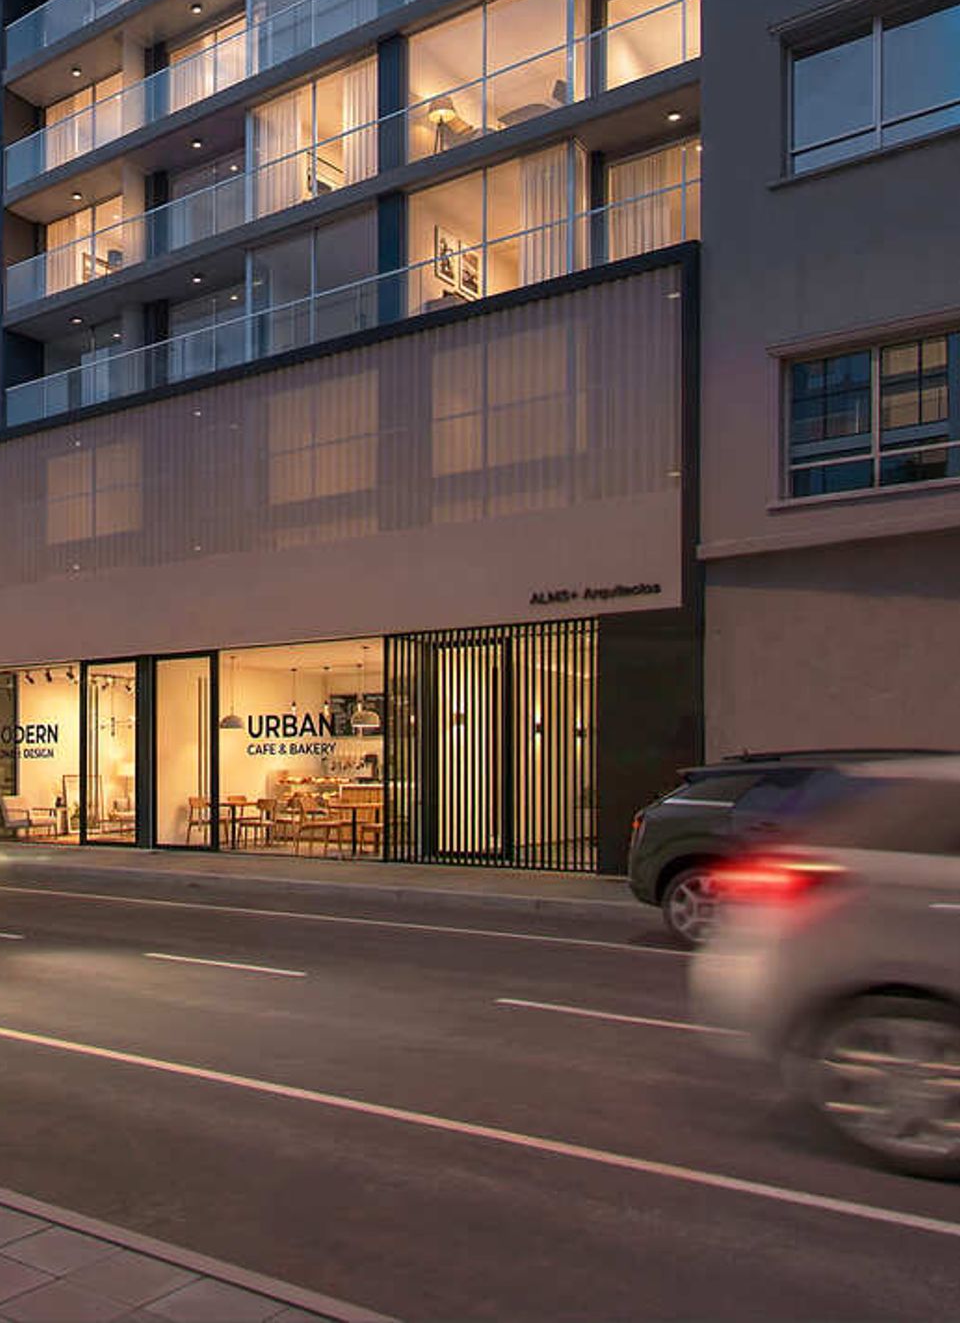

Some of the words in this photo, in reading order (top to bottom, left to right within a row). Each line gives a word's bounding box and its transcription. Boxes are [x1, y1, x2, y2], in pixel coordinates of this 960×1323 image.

[248, 712, 335, 738] URBAN
[23, 748, 54, 759] DESIGN
[247, 743, 276, 755] CAFE
[279, 743, 287, 754] &
[289, 742, 336, 755] BAKERY
